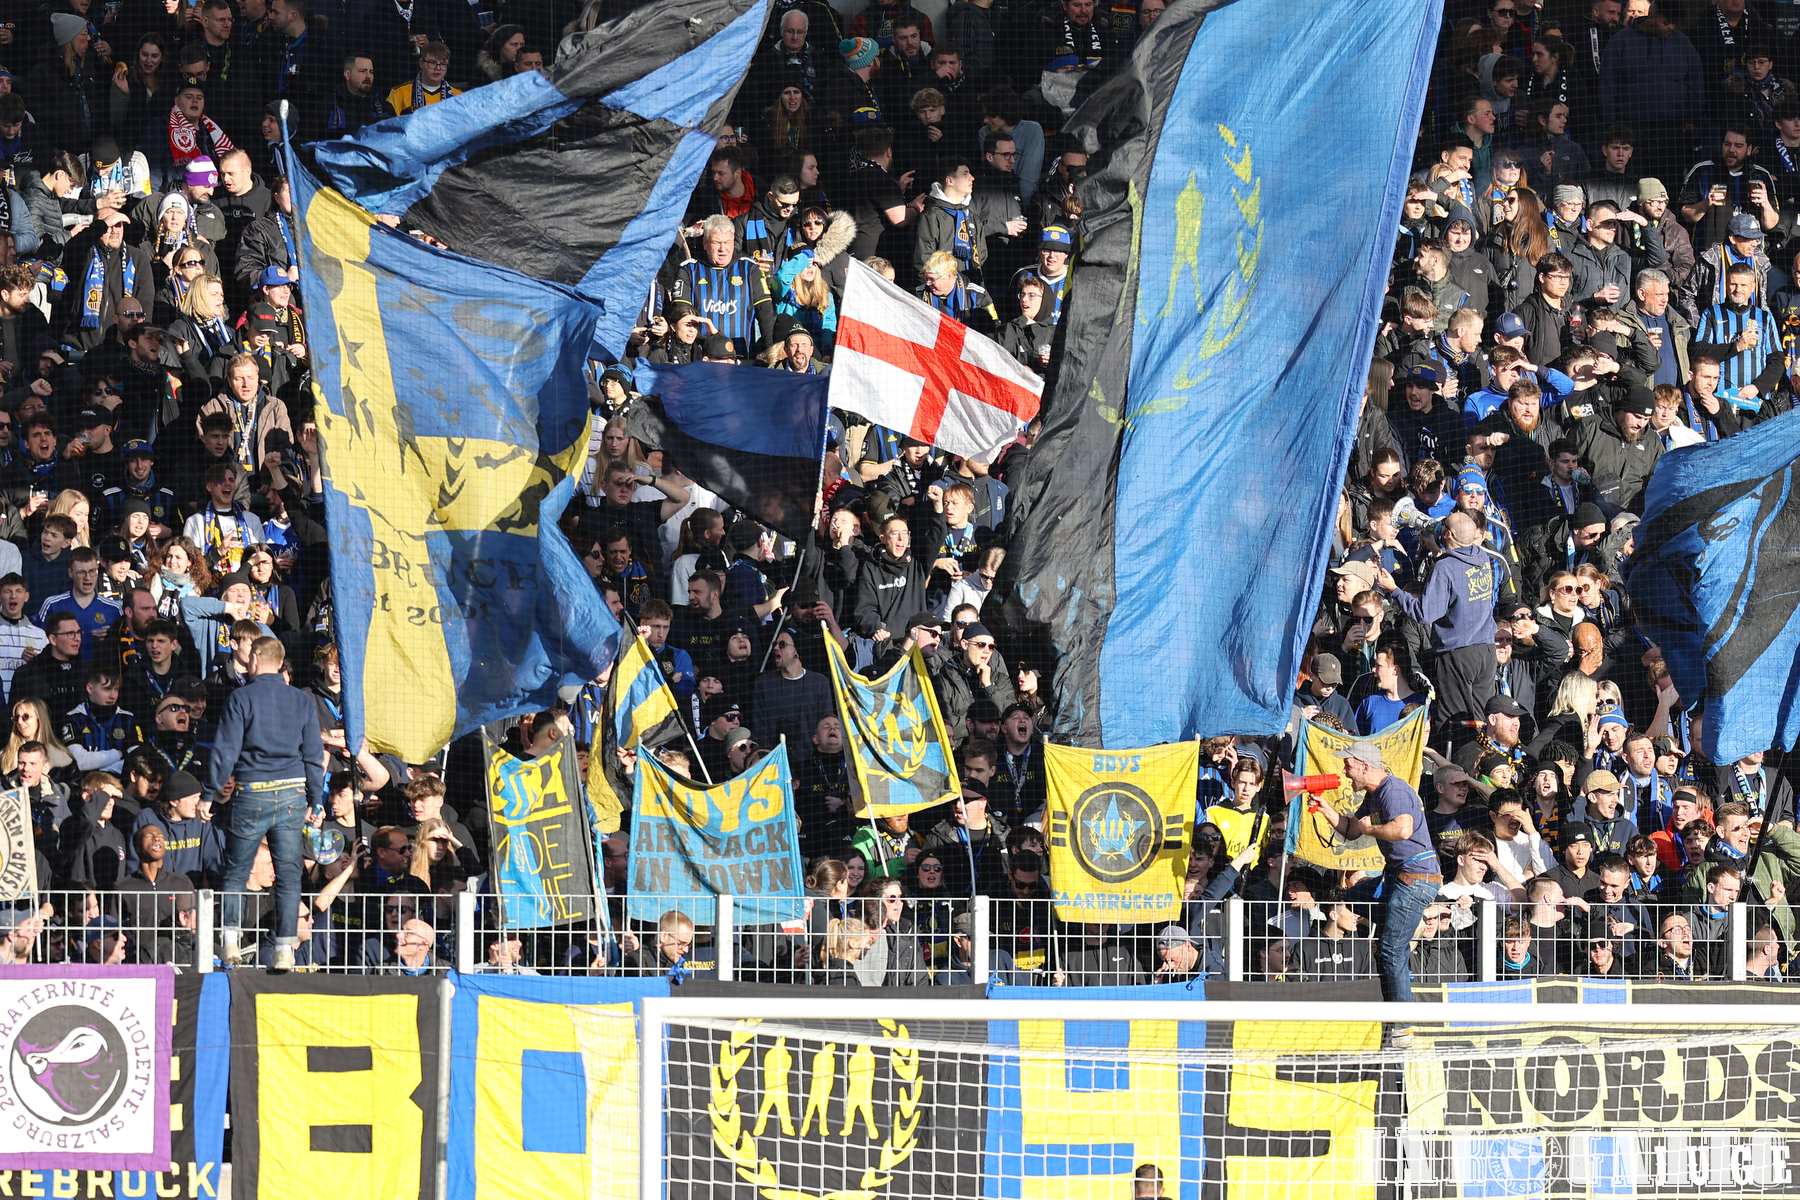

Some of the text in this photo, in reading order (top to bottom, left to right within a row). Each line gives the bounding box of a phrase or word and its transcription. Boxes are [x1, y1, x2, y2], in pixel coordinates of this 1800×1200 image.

[703, 298, 738, 315] Victor's
[407, 602, 492, 626] 2001
[1093, 754, 1142, 773] BOYS
[639, 758, 784, 832] BOYS
[635, 821, 791, 860] ARE BACK
[2, 851, 27, 889] SAAR
[633, 857, 794, 894] IN TOWN
[1339, 855, 1384, 869] ULTR
[1051, 889, 1173, 910] SAARBRÜCKEN
[0, 981, 115, 1047] RATERNITÉ
[119, 1007, 151, 1115] VIOLETTE
[1434, 1036, 1800, 1126] NORDS
[13, 1114, 125, 1149] SALZBURG
